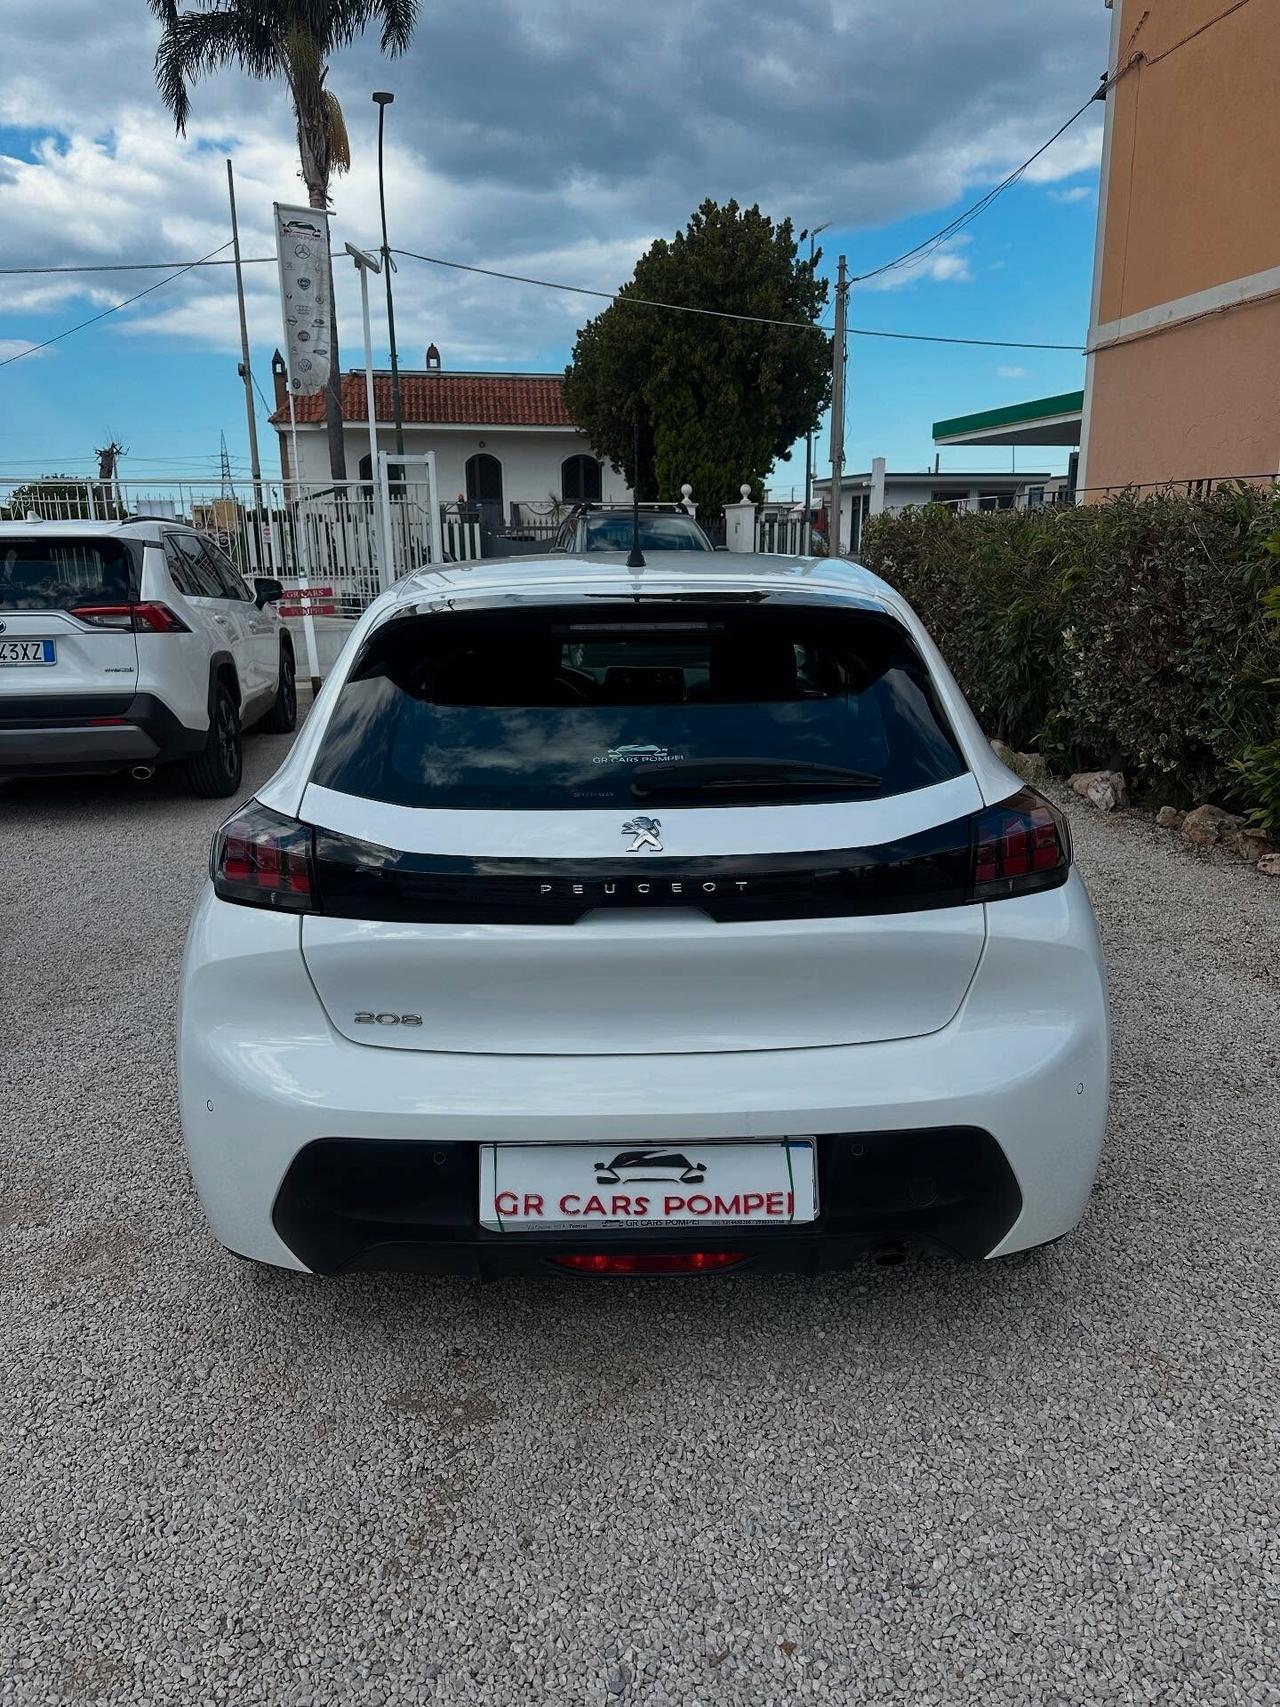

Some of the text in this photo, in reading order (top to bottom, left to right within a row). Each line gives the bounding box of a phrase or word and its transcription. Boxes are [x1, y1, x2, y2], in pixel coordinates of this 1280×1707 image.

[301, 589, 324, 597] CARS
[592, 756, 608, 764] GR
[641, 754, 685, 762] POMPEI
[540, 881, 748, 894] PEUGEOT
[354, 1012, 423, 1026] 208
[494, 1191, 794, 1216] GR CARS POMPEI
[626, 1219, 639, 1227] GR
